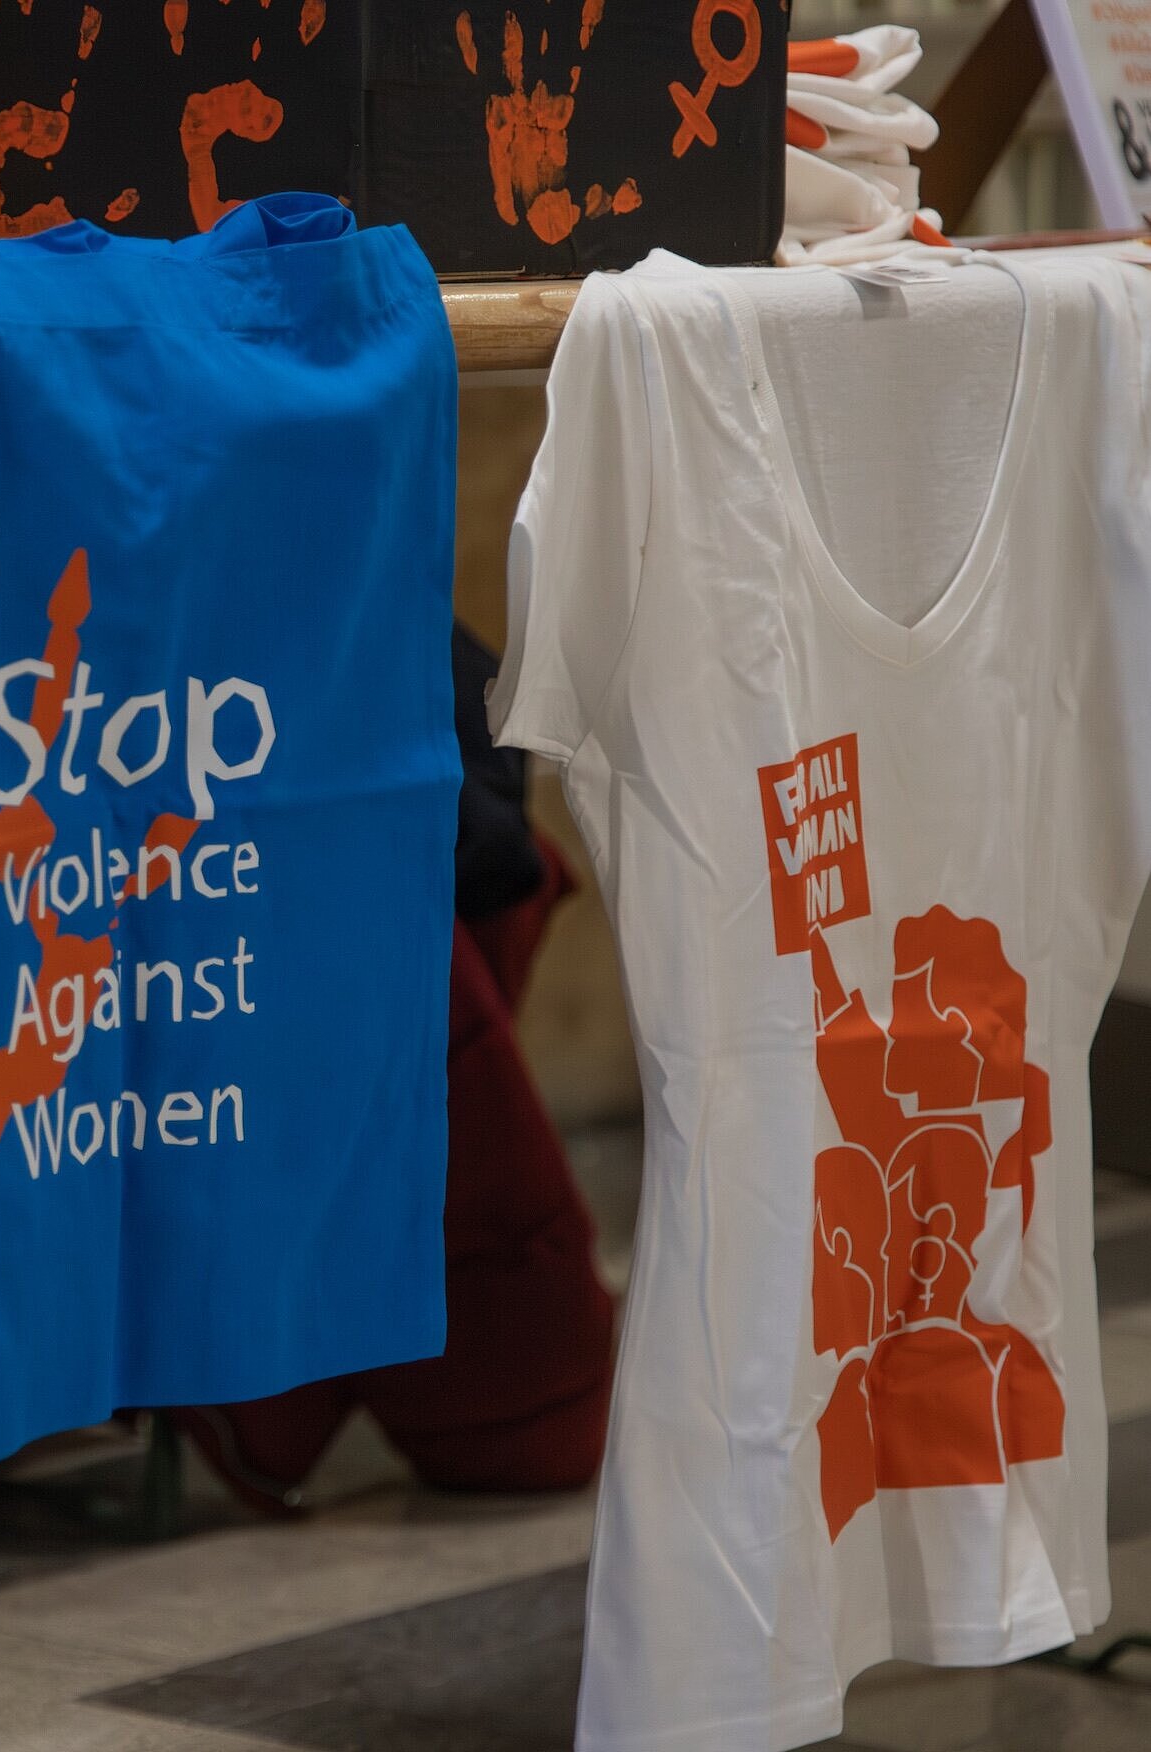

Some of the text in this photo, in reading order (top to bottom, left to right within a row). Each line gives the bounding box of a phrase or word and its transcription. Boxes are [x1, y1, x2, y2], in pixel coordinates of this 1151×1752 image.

[809, 747, 848, 803] ALL
[3, 827, 260, 925] Violence
[7, 936, 256, 1063] Against
